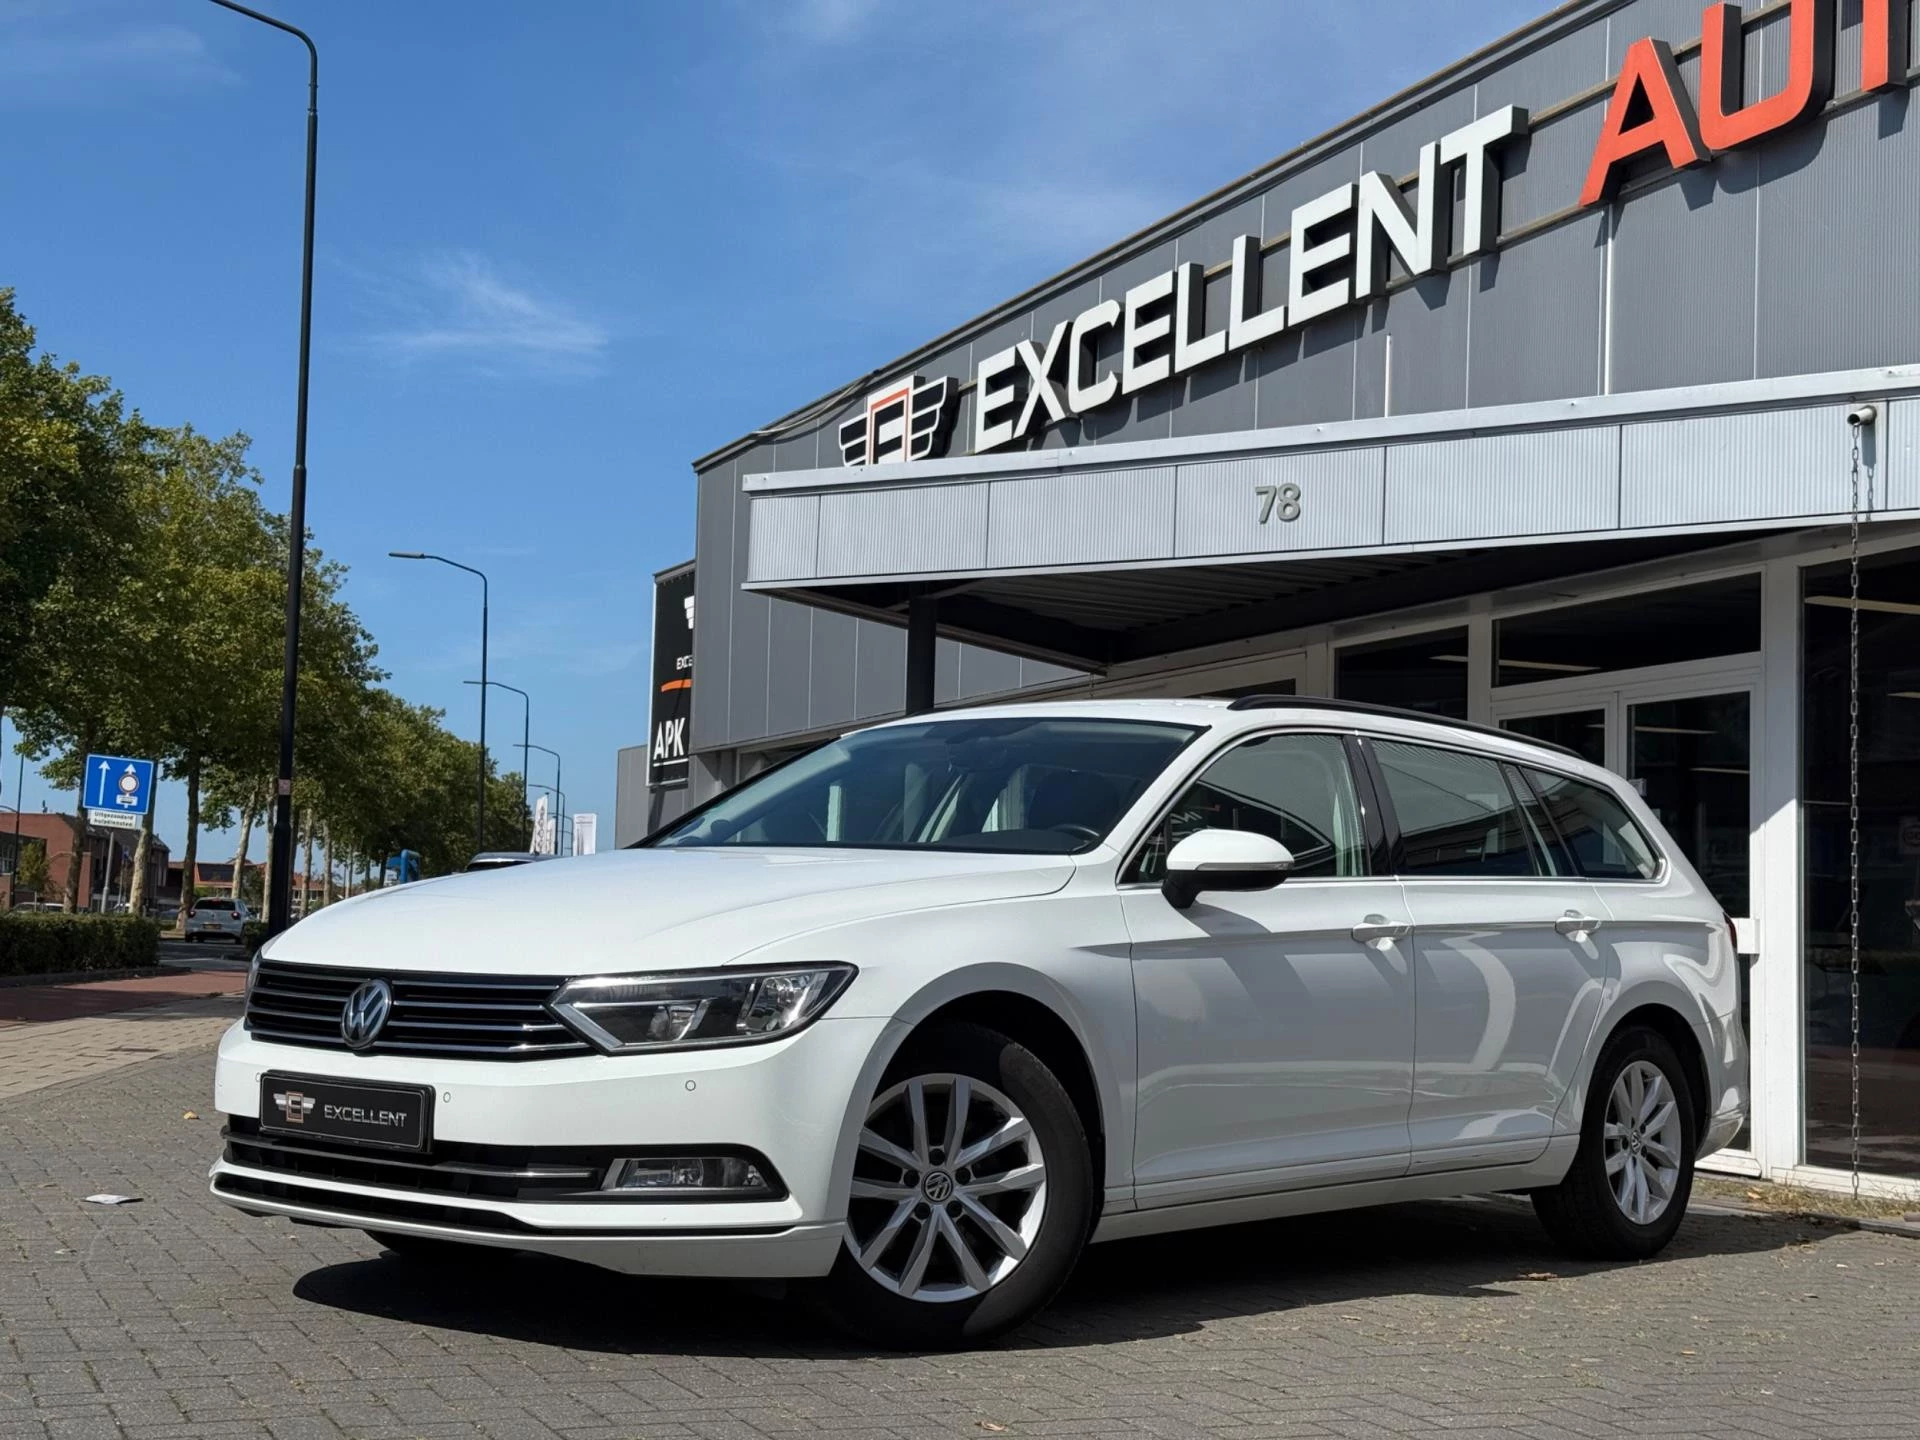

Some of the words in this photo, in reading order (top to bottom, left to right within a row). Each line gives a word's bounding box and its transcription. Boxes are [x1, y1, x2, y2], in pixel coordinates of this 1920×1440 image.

[975, 104, 1514, 454] EXCELLENT
[1255, 483, 1301, 524] 78
[653, 717, 685, 760] APK
[324, 1104, 407, 1127] EXCELLENT
